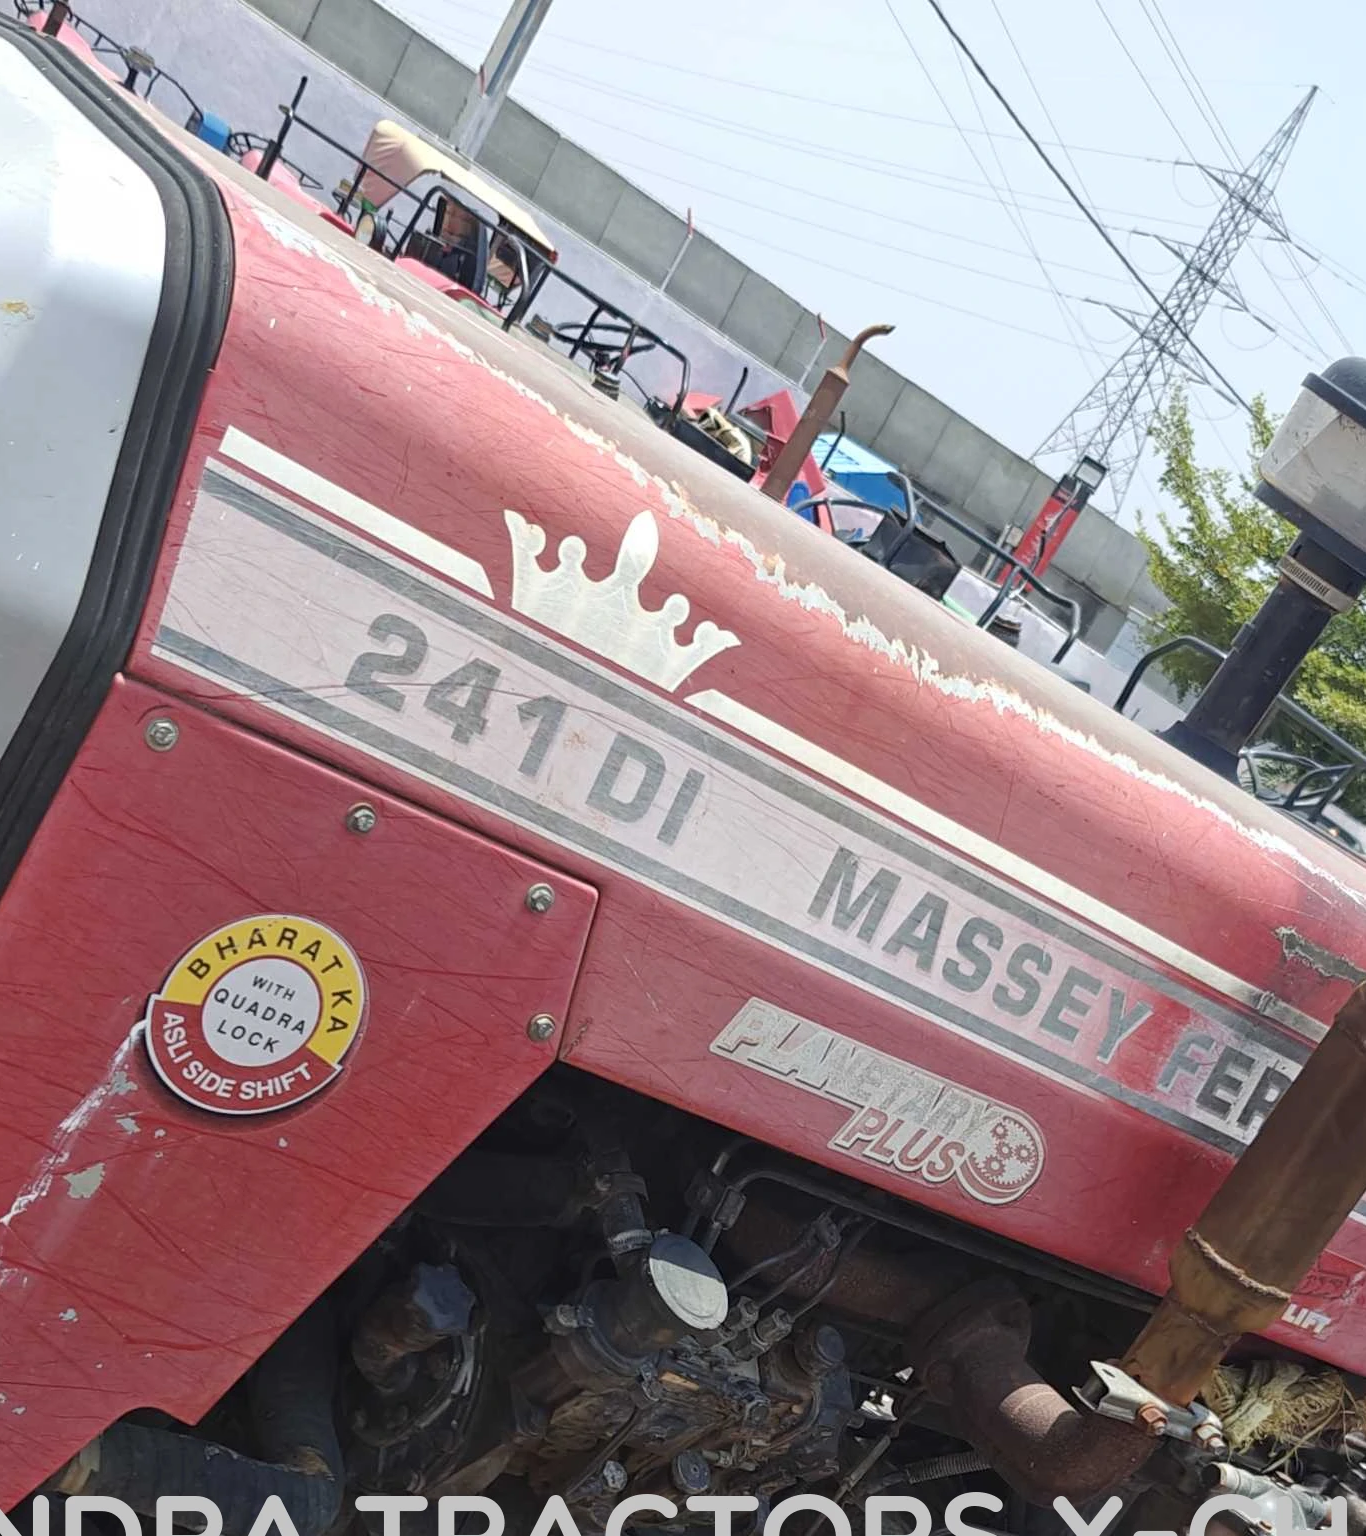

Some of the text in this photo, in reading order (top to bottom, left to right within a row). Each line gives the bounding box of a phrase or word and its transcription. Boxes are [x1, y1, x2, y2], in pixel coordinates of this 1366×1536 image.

[344, 613, 570, 782] 241
[586, 732, 707, 847] DI
[807, 845, 1154, 1064] MASSEY
[186, 926, 354, 1034] BHARAT KA
[213, 987, 307, 1035] QUADRA
[251, 975, 296, 1001] WITH
[162, 1011, 312, 1100] ASLI SIDE SHIFT
[217, 1019, 282, 1053] LOCK
[834, 1106, 967, 1183] PLUS
[1281, 1303, 1332, 1334] LIFT
